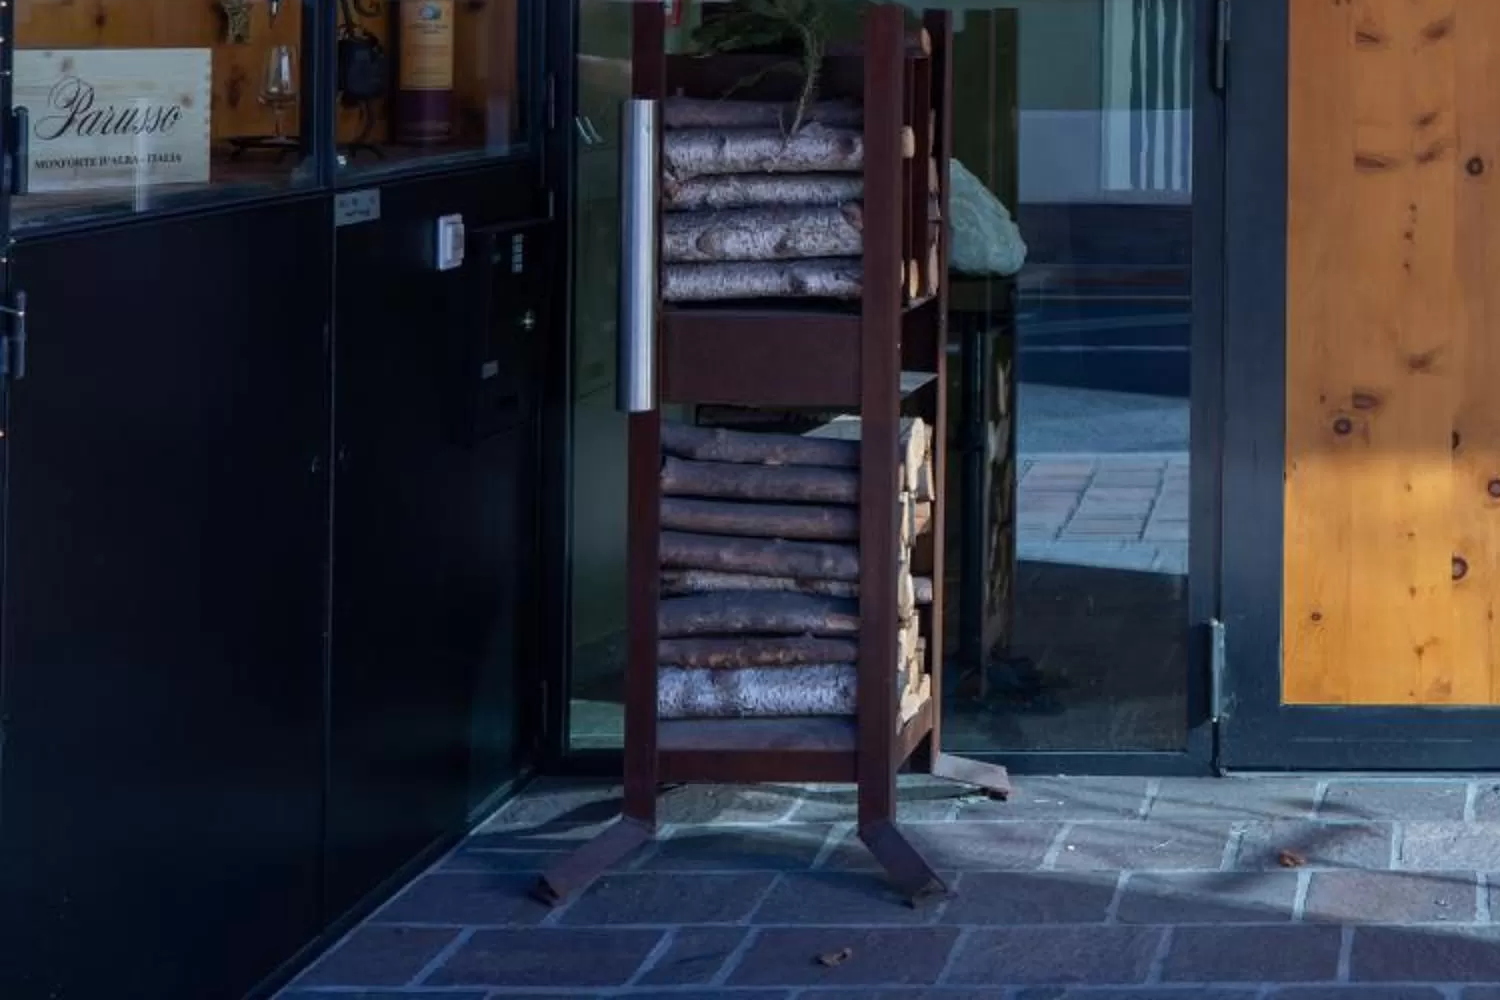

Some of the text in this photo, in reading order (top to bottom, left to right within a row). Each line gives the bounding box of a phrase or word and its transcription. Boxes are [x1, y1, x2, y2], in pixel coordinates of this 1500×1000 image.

[33, 75, 182, 140] Parusso
[34, 156, 97, 169] MONFORTE
[146, 151, 183, 164] ITALIA
